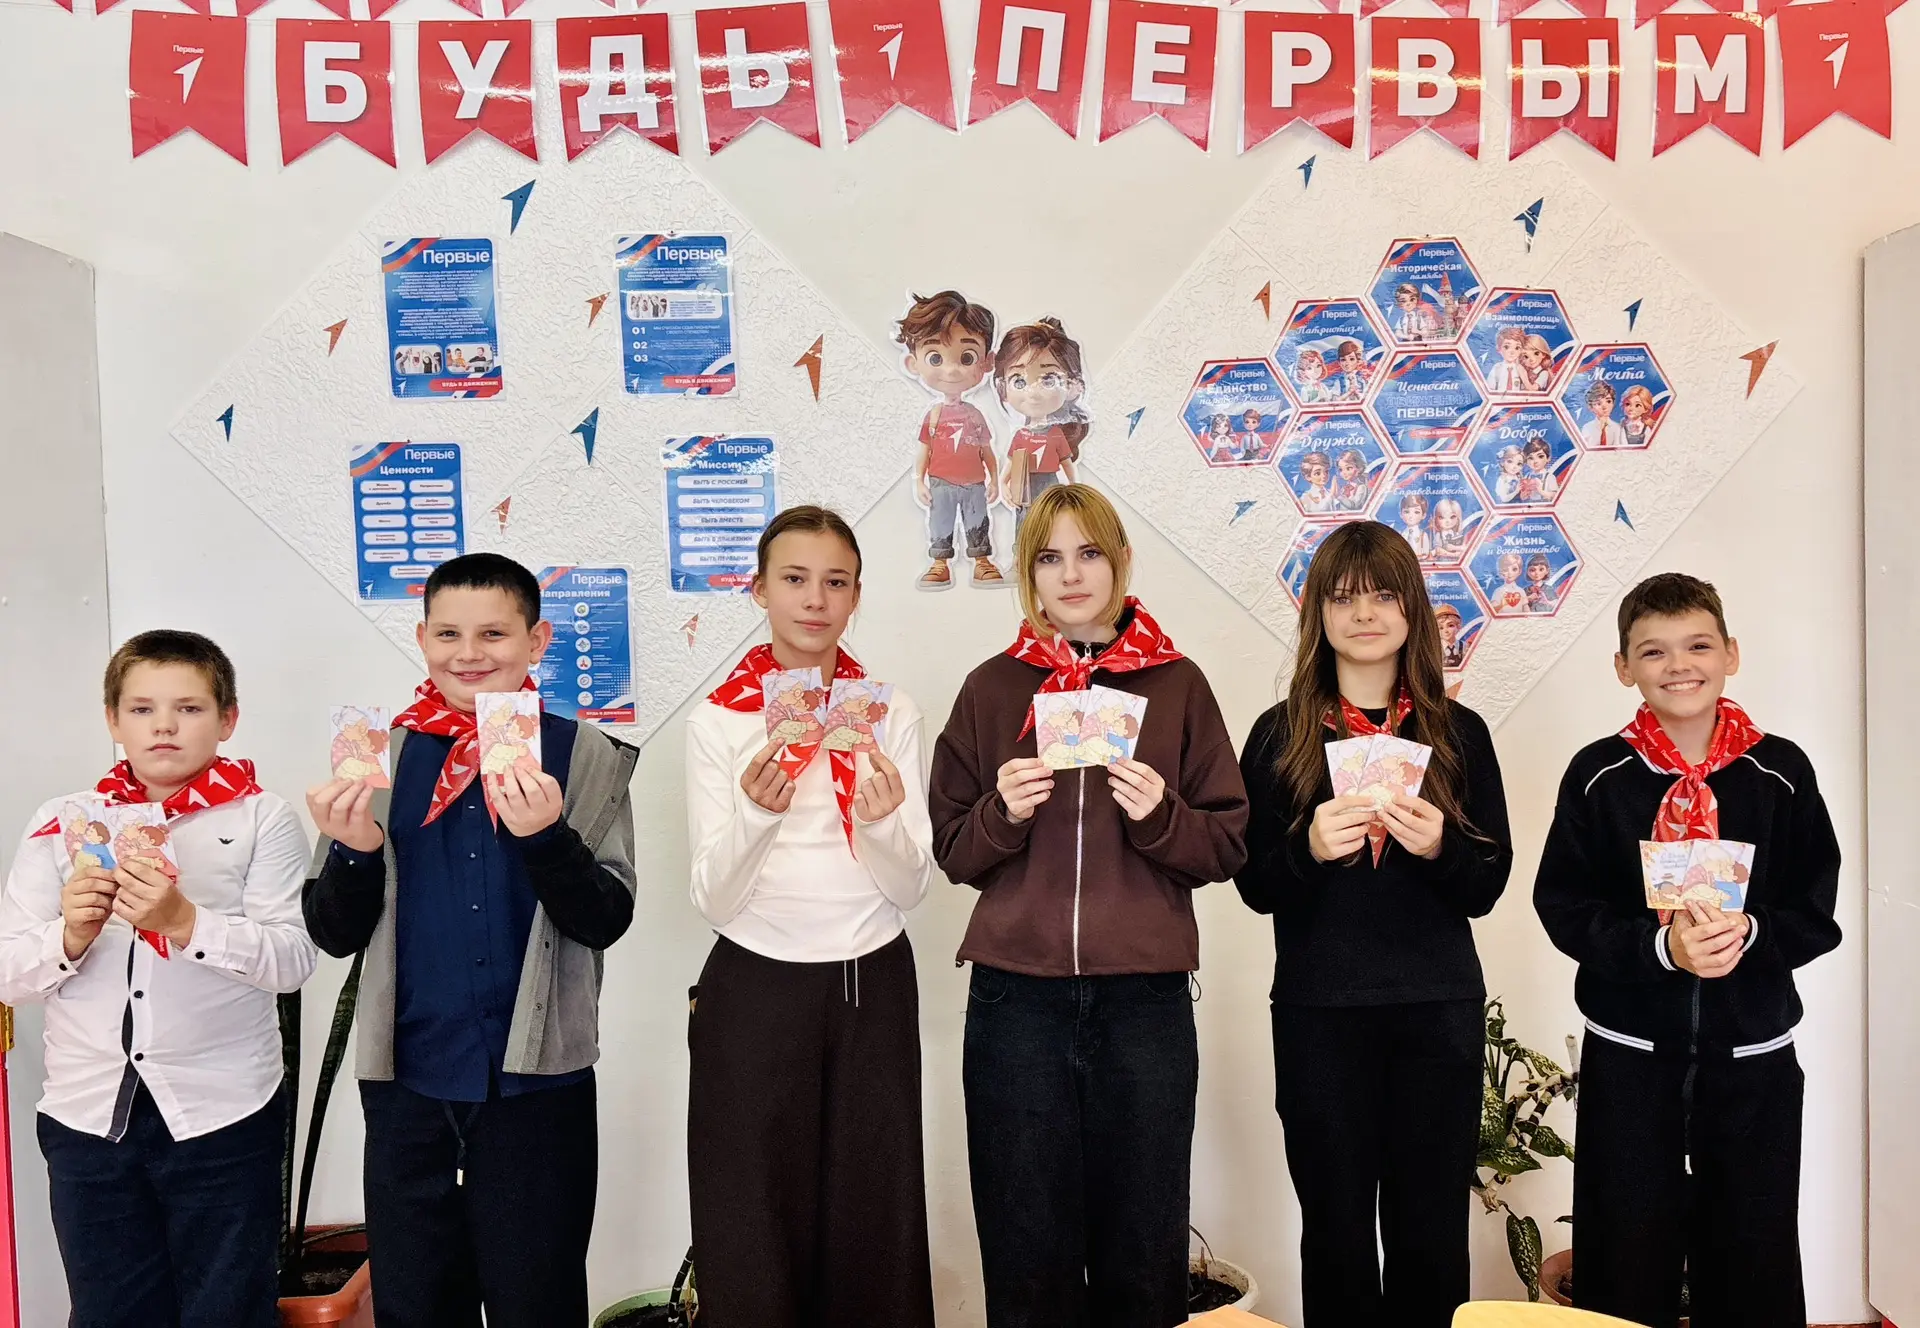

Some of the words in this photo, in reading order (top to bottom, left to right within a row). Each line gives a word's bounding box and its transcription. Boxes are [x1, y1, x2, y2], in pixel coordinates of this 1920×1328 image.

[303, 28, 788, 132] БУДЬ
[996, 6, 1748, 117] ПЕРВЫМ
[657, 246, 724, 264] Первые
[1419, 249, 1454, 258] Первые
[423, 250, 489, 268] Первые
[1390, 263, 1461, 273] Историческая
[1517, 299, 1552, 309] Первые
[1323, 311, 1357, 320] Первые
[1296, 325, 1363, 335] Патриотизм
[633, 341, 647, 349] 02
[1610, 355, 1645, 364] Первые
[1421, 361, 1456, 370] Первые
[1230, 371, 1265, 380] Первые
[1588, 367, 1645, 381] Мечта
[1207, 383, 1267, 394] Единство
[1397, 381, 1459, 395] Ценности
[1397, 407, 1458, 418] ПЕРВЫХ
[1517, 413, 1552, 422] Первые
[1325, 422, 1360, 430] Первые
[1499, 425, 1548, 443] Добро
[1301, 433, 1365, 451] Дружба
[718, 444, 768, 456] Первые
[405, 449, 455, 463] Первые
[380, 466, 433, 475] Ценности
[1424, 473, 1459, 482] Первые
[1518, 524, 1552, 533] Первые
[1503, 536, 1545, 546] Жизнь
[572, 574, 622, 587] Первые
